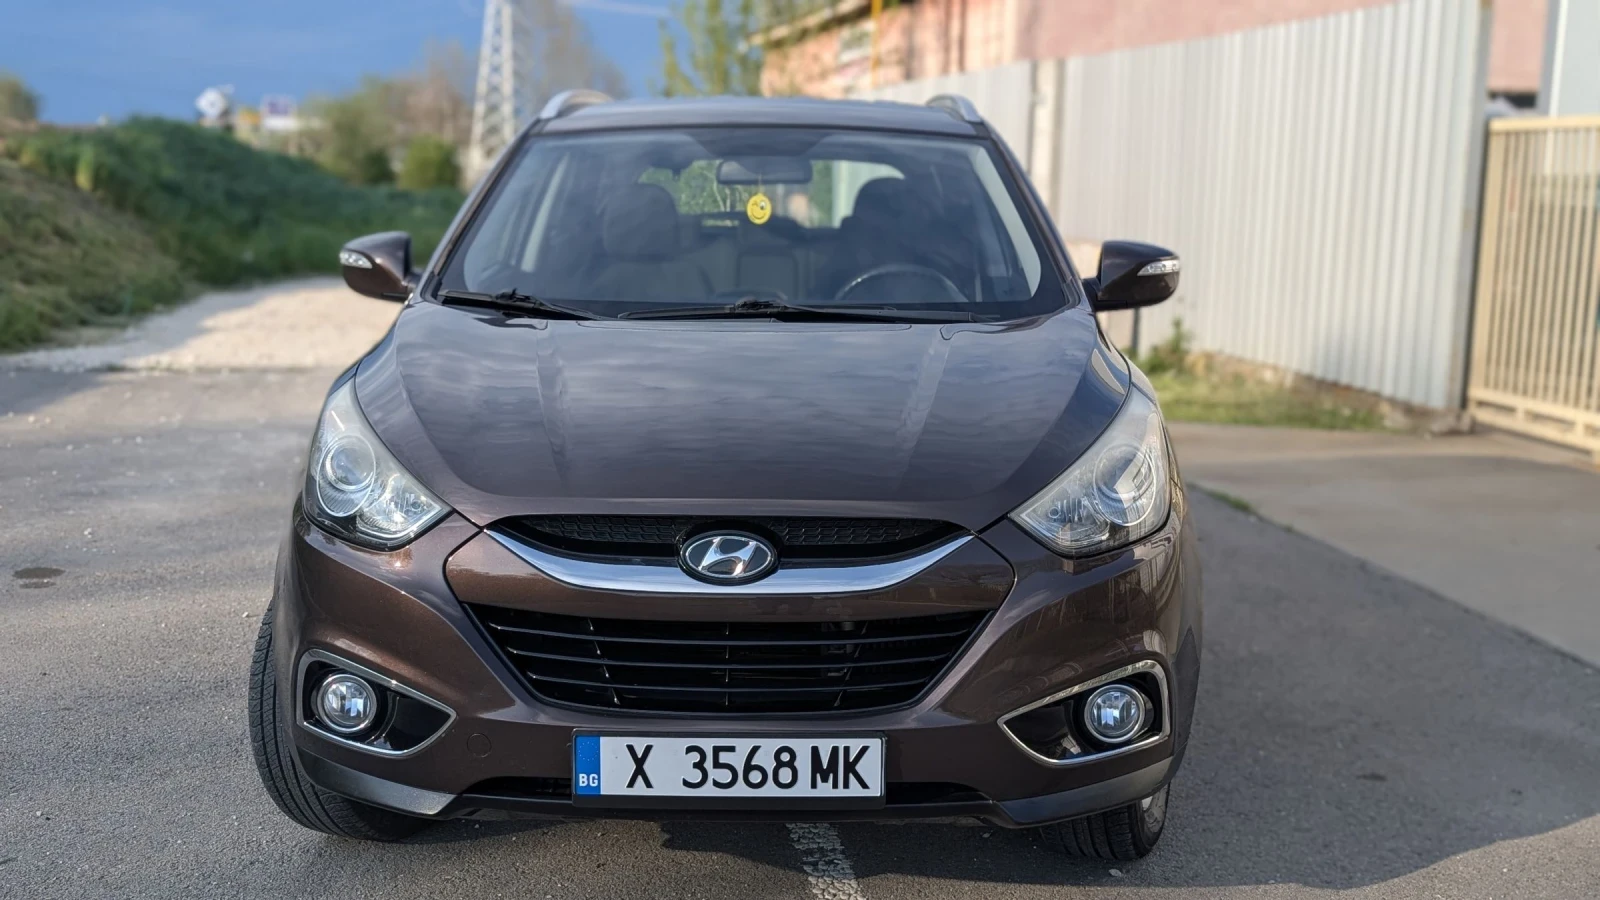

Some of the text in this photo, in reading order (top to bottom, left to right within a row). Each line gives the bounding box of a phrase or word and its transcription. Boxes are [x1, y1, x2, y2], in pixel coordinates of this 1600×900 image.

[579, 773, 598, 786] BG
[625, 744, 870, 790] X 3568 MK
